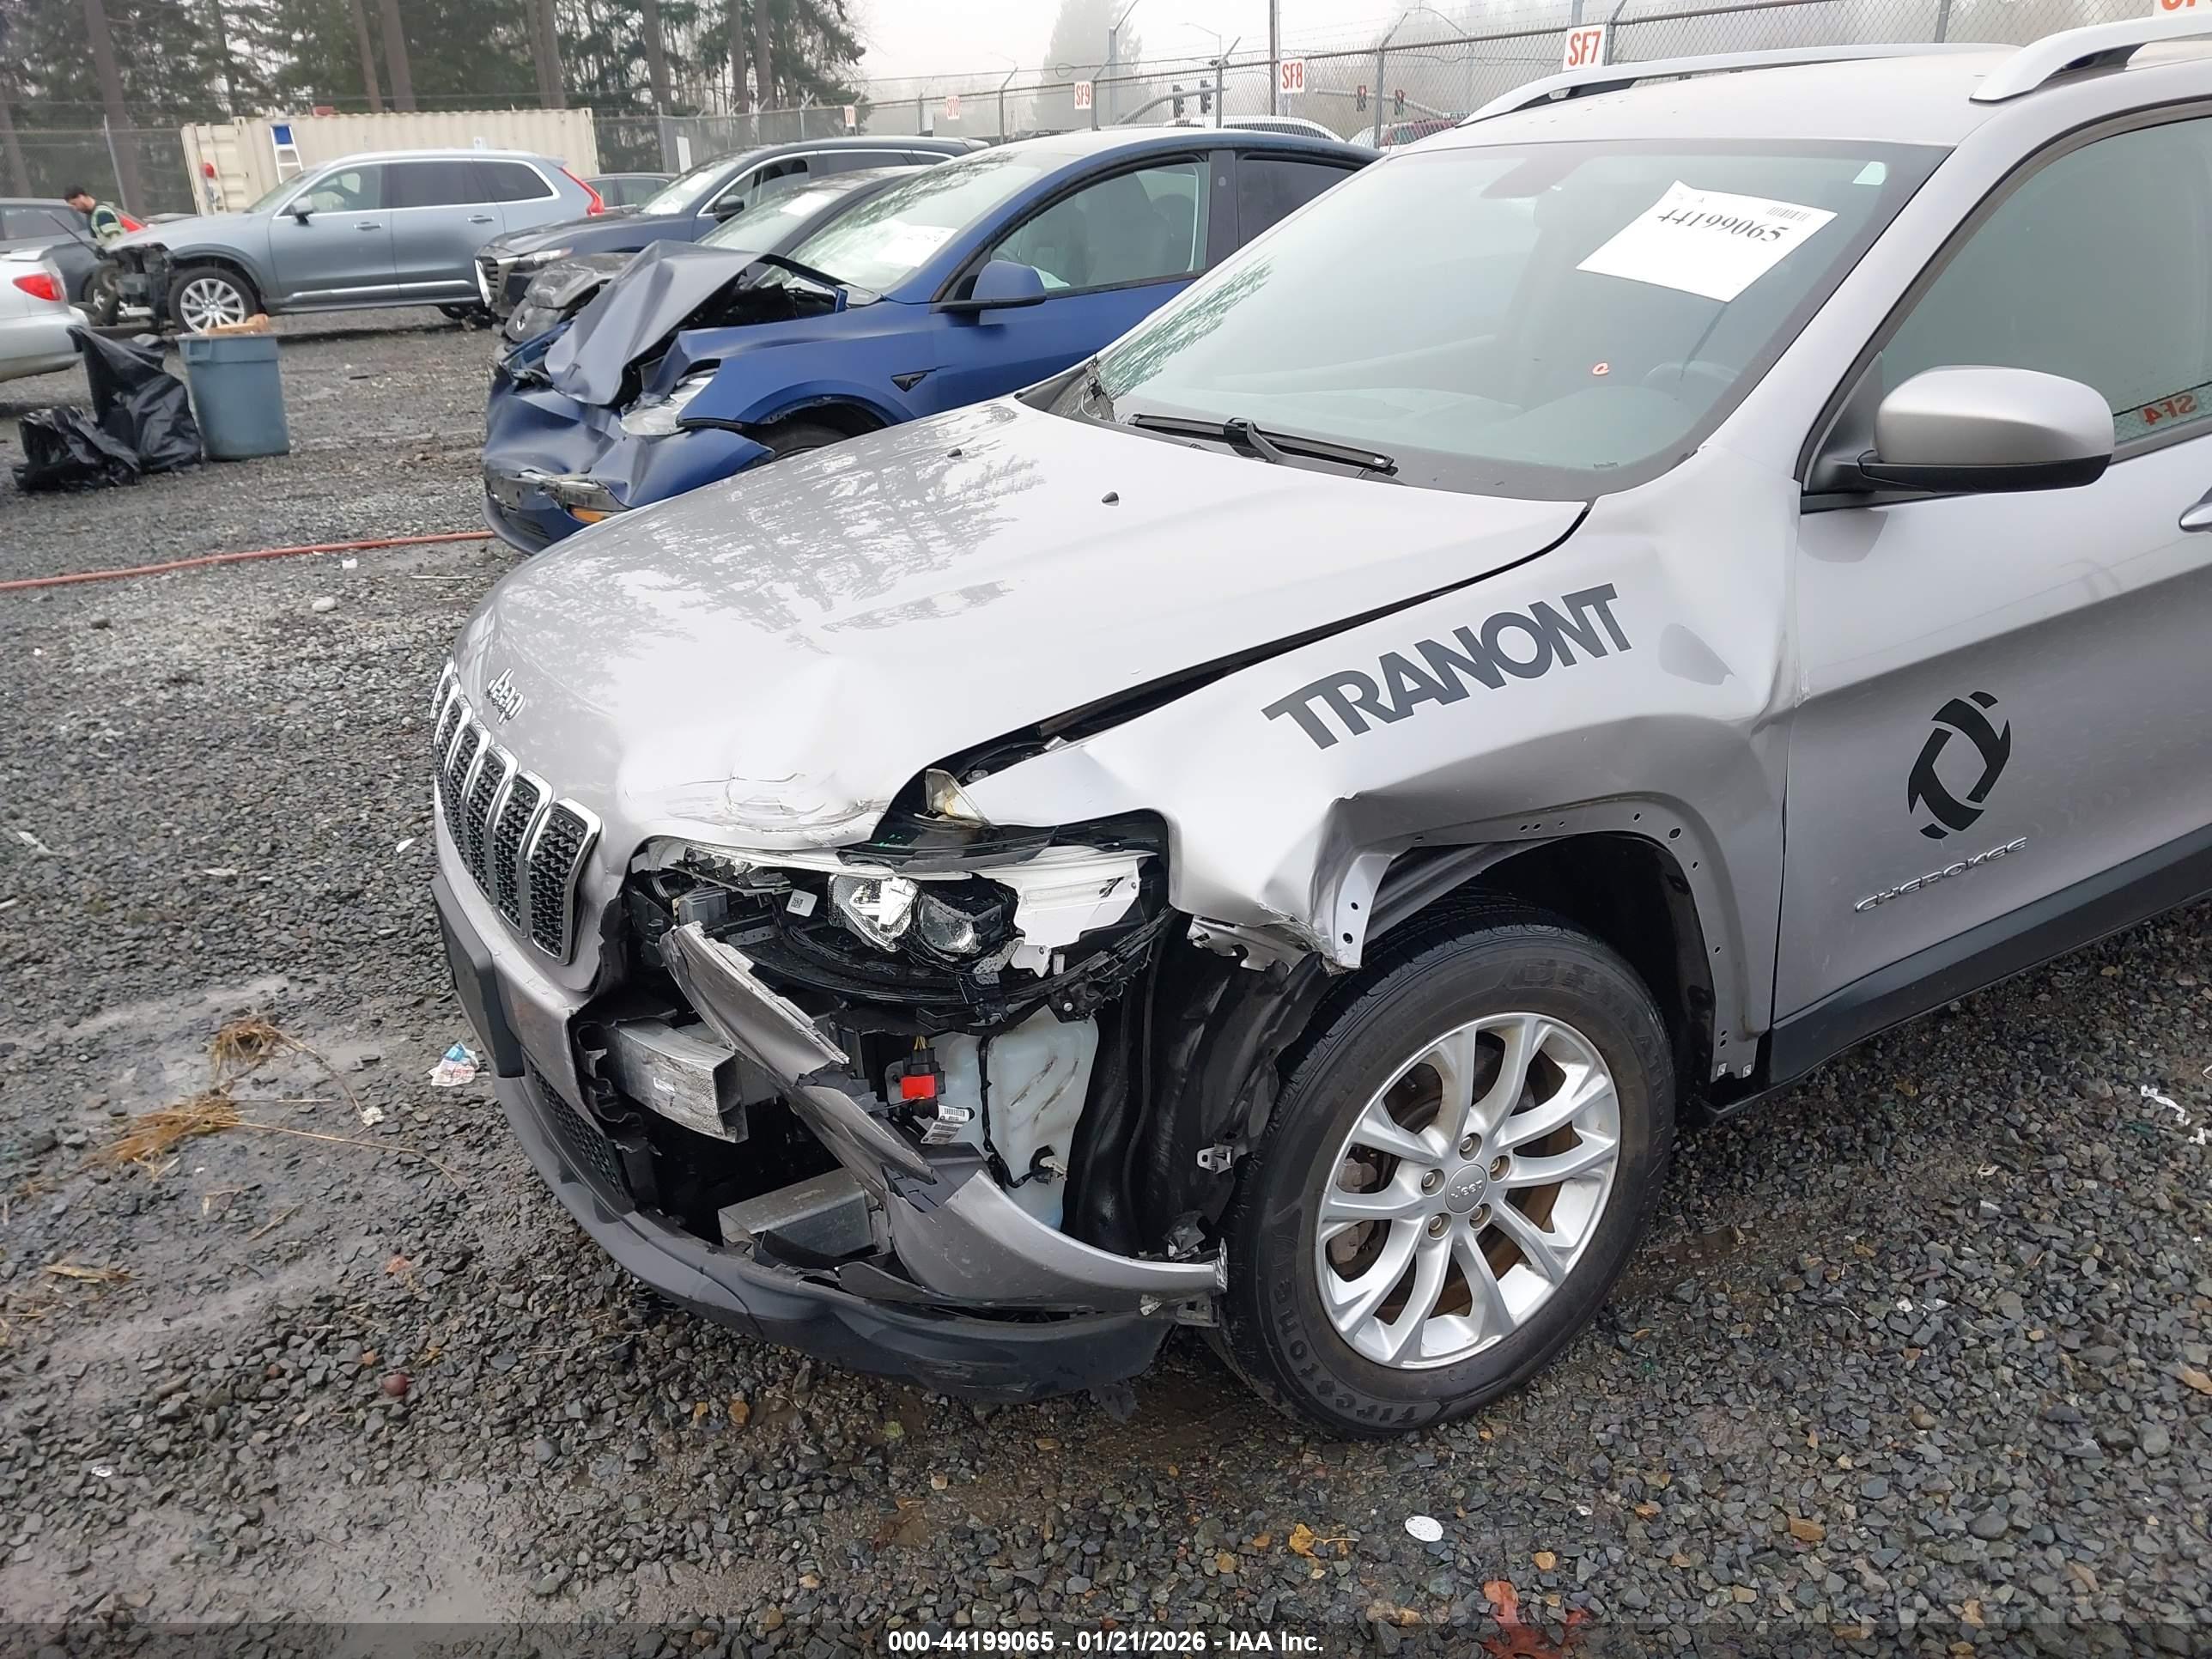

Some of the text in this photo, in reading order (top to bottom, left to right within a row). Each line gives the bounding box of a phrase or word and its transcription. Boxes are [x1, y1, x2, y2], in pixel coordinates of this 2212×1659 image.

[1568, 30, 1601, 66] SF7
[1282, 62, 1303, 89] SF8
[1076, 84, 1090, 106] SF9
[1657, 208, 1790, 242] 44199065
[1261, 582, 1632, 750] TRANONT
[487, 667, 525, 725] Jeep
[1855, 836, 2027, 913] CHEROKEE
[1450, 1179, 1483, 1198] Jeep
